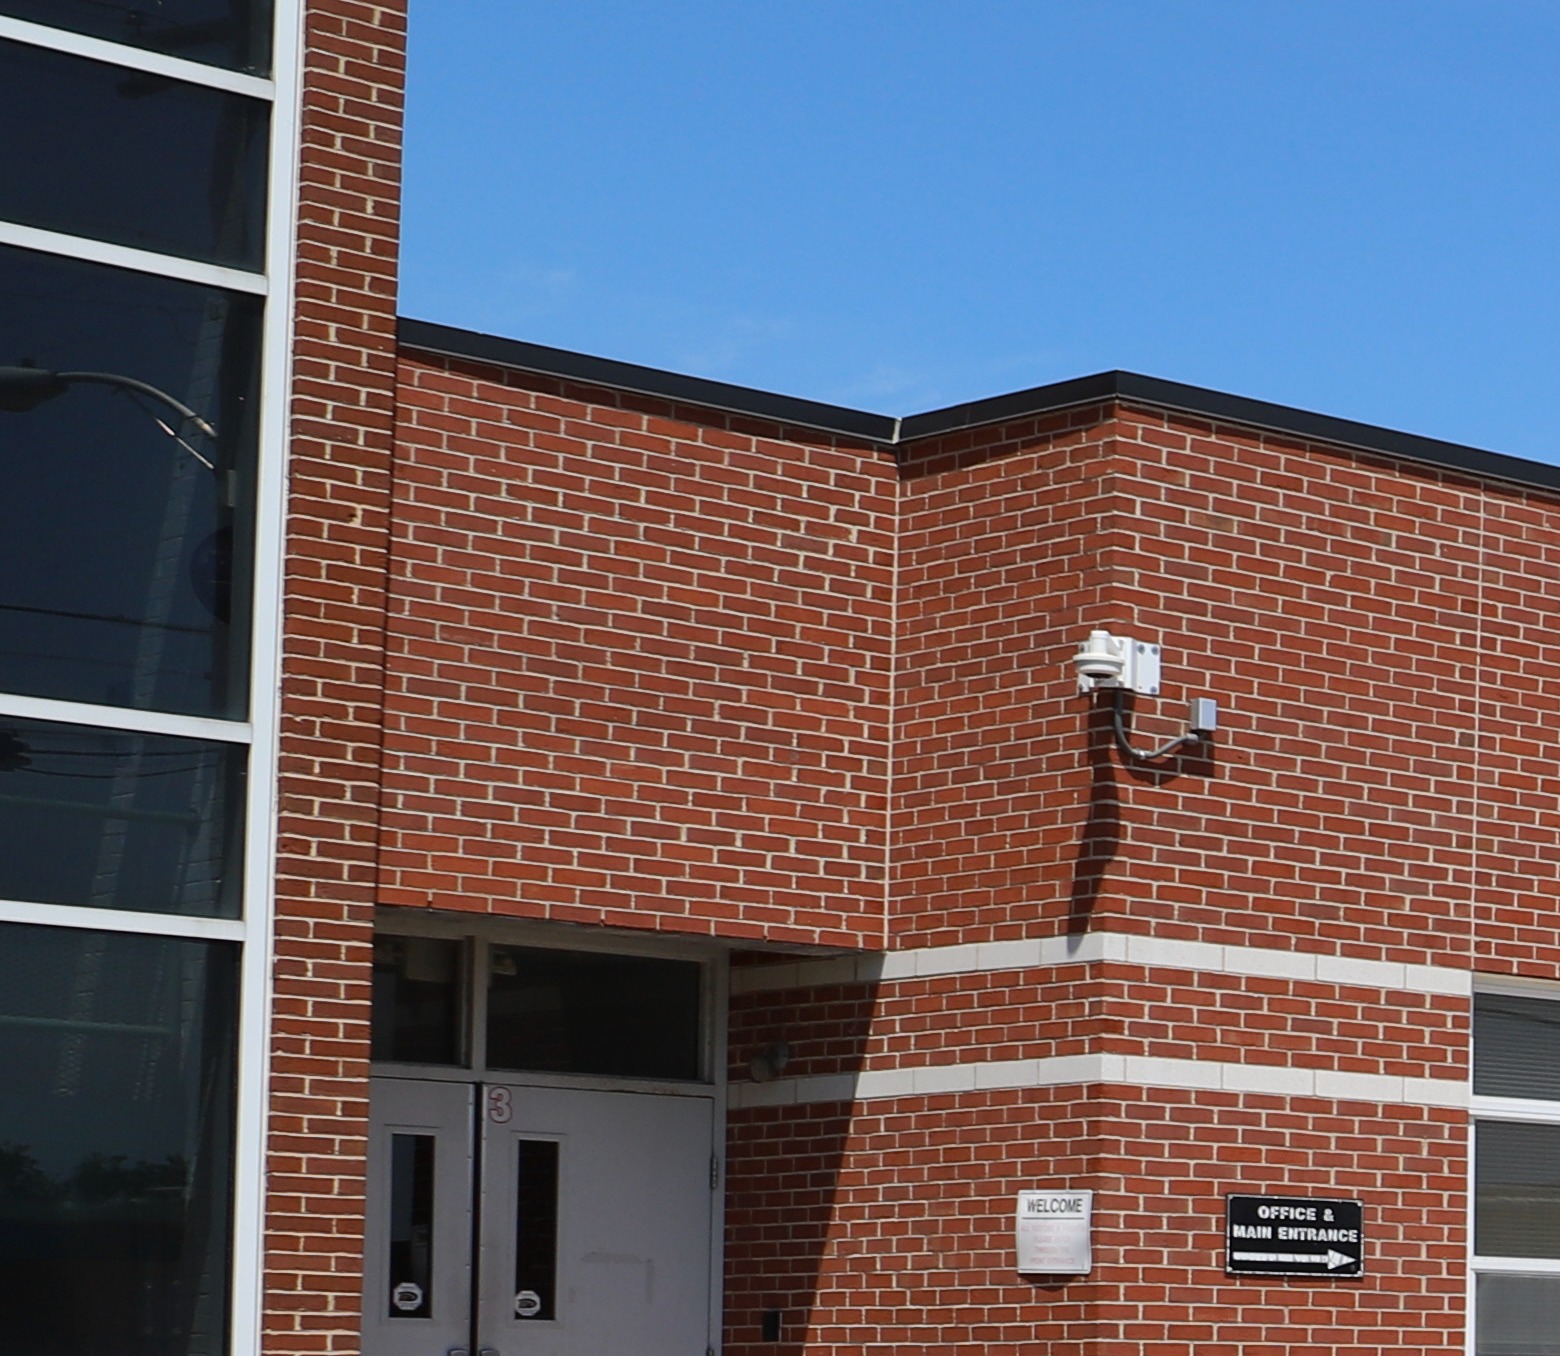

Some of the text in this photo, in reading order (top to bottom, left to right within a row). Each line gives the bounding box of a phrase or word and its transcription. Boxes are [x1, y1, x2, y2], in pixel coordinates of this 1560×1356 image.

[488, 1086, 512, 1124] 3
[1027, 1198, 1083, 1213] WELCOME
[1257, 1205, 1335, 1222] OFFICE &
[1232, 1224, 1358, 1243] MAIN ENTRANCE
